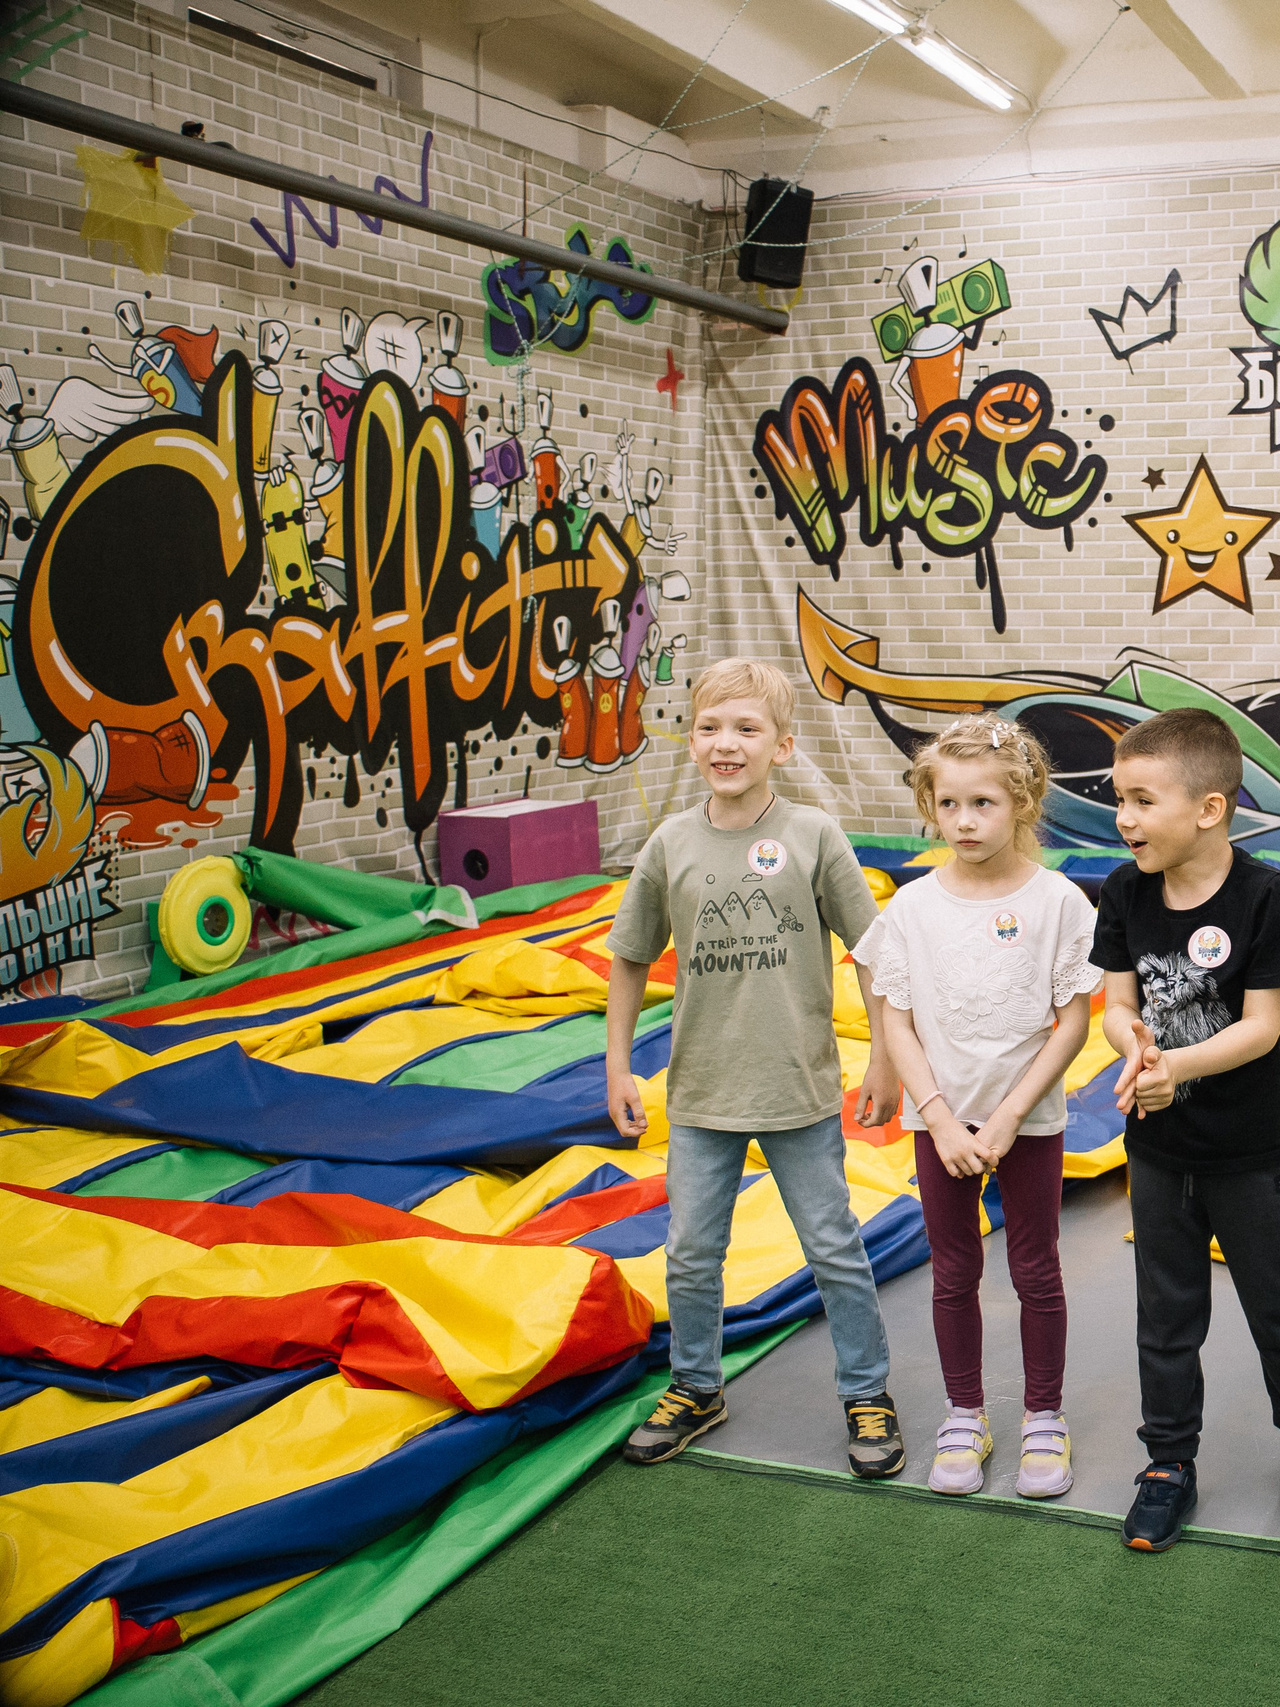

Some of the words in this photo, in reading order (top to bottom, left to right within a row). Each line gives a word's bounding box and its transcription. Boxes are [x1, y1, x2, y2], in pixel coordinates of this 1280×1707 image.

[696, 941, 705, 953] A
[741, 936, 754, 946] TO
[758, 934, 778, 945] THE
